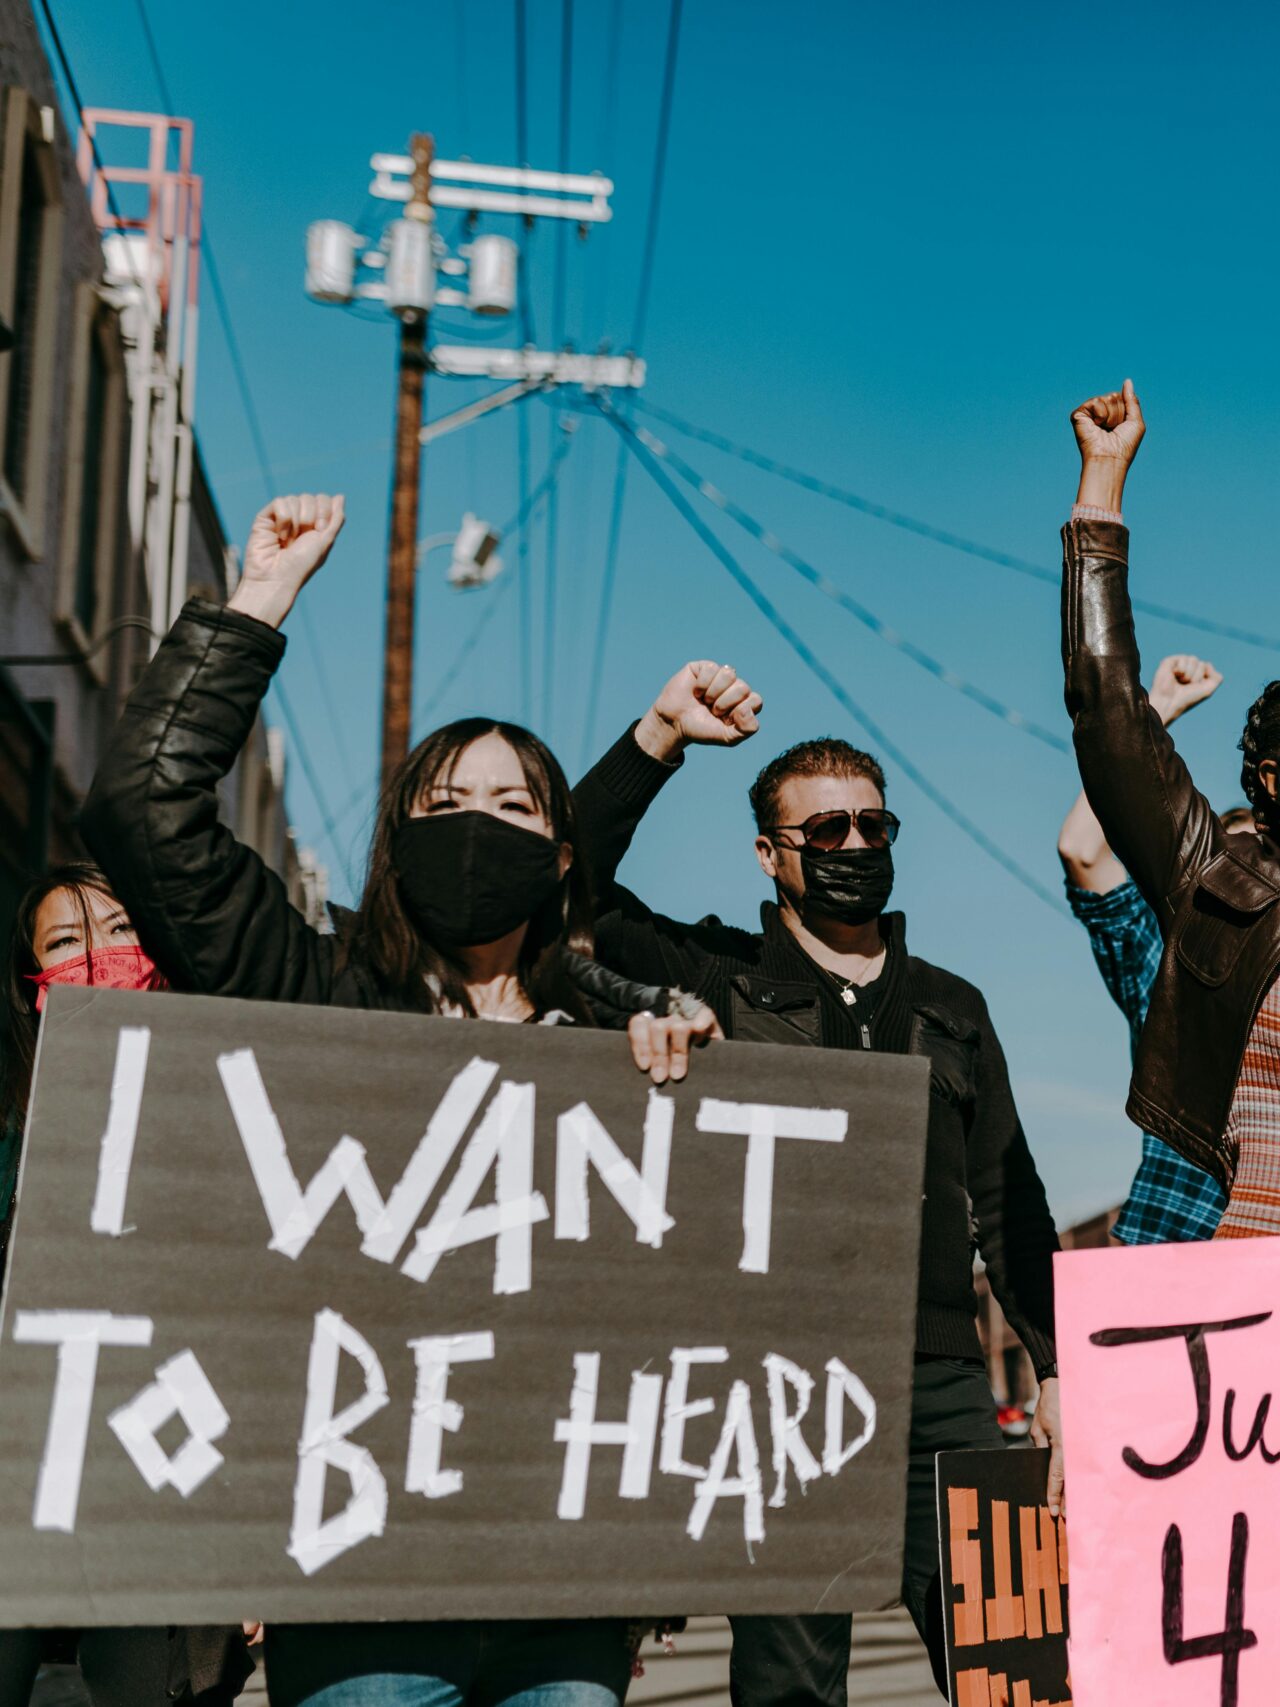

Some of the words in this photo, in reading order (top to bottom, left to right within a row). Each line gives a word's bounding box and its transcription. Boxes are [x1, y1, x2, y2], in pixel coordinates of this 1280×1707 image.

[91, 1026, 151, 1236] I
[217, 1047, 849, 1294] WANT
[13, 1309, 231, 1534] TO
[287, 1308, 495, 1575] BE
[553, 1346, 877, 1545] HEARD
[947, 1486, 1069, 1647] HTS
[1161, 1511, 1258, 1707] 4
